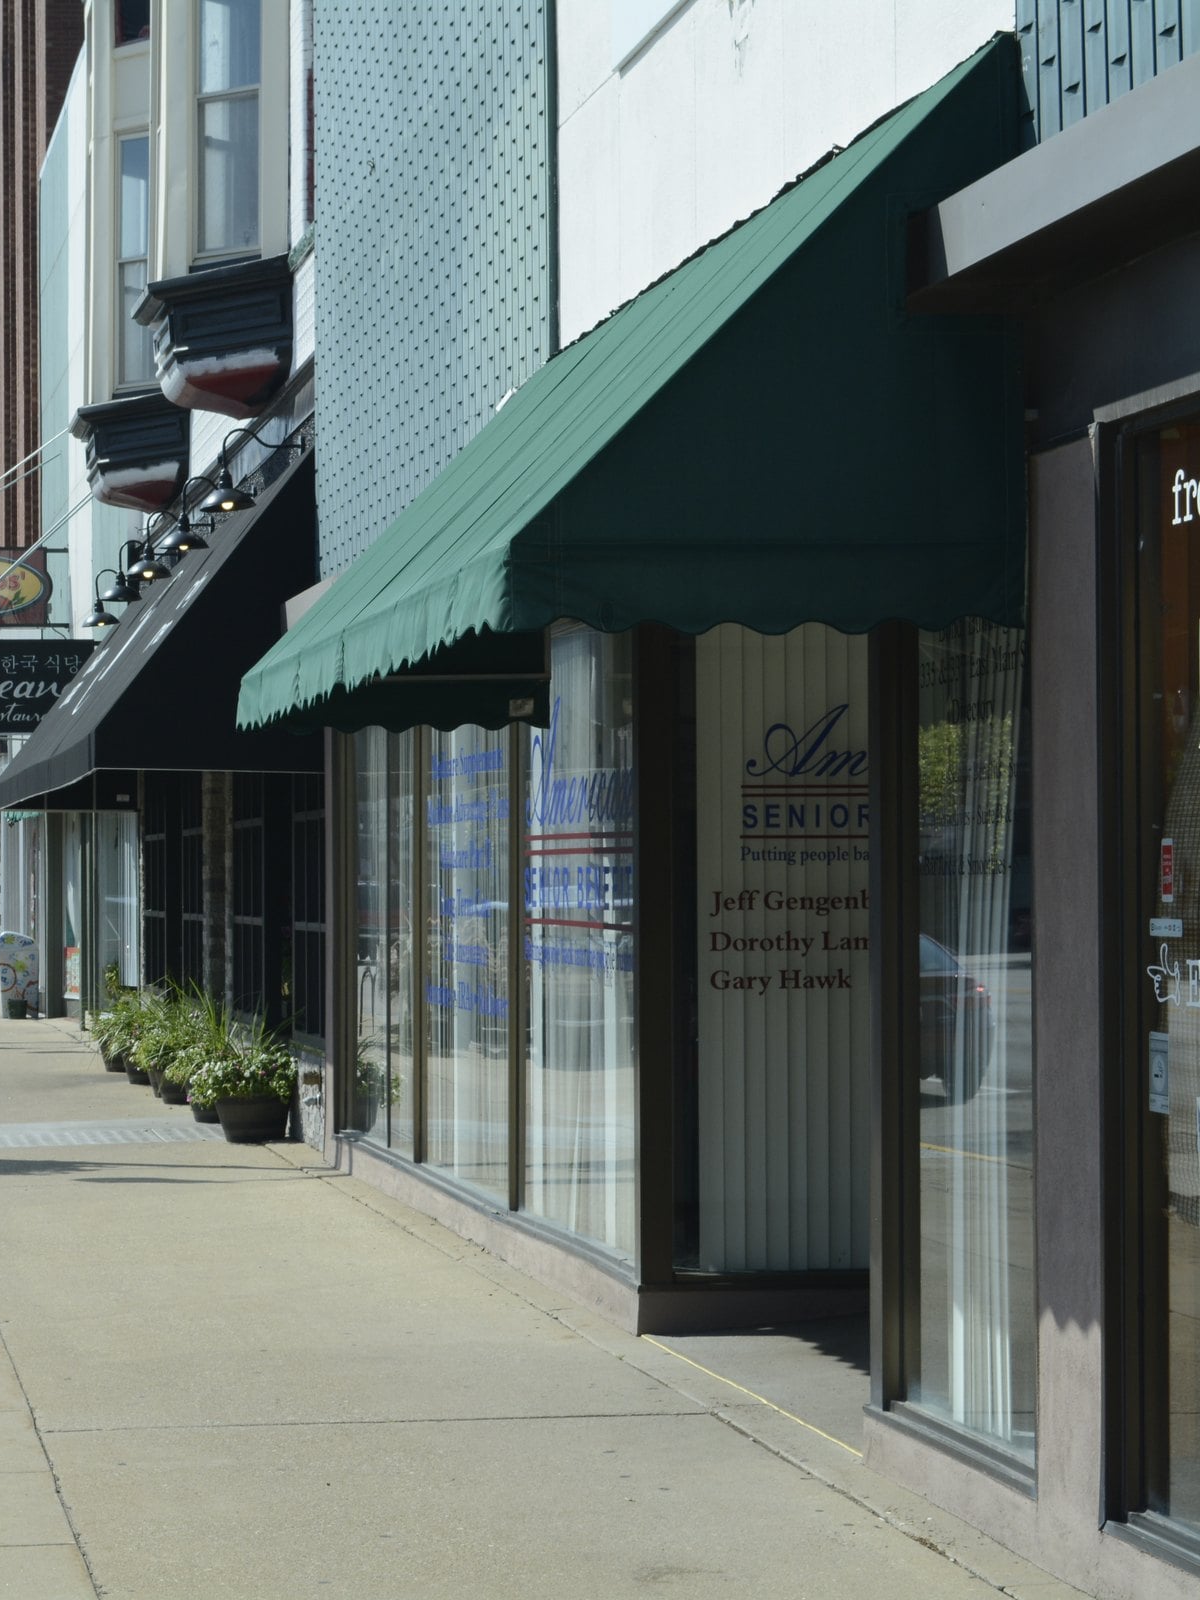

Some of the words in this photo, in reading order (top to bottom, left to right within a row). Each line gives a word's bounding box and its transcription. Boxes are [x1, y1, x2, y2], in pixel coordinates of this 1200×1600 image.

[1172, 469, 1200, 526] fr
[1, 654, 38, 674] 한국
[44, 654, 82, 674] 식당
[740, 846, 797, 867] Putting
[800, 846, 849, 867] people
[524, 866, 569, 910] SENIOR
[710, 890, 760, 918] Jeff
[710, 930, 815, 957] Dorothy
[710, 970, 772, 996] Gary
[778, 969, 851, 990] Hawk
